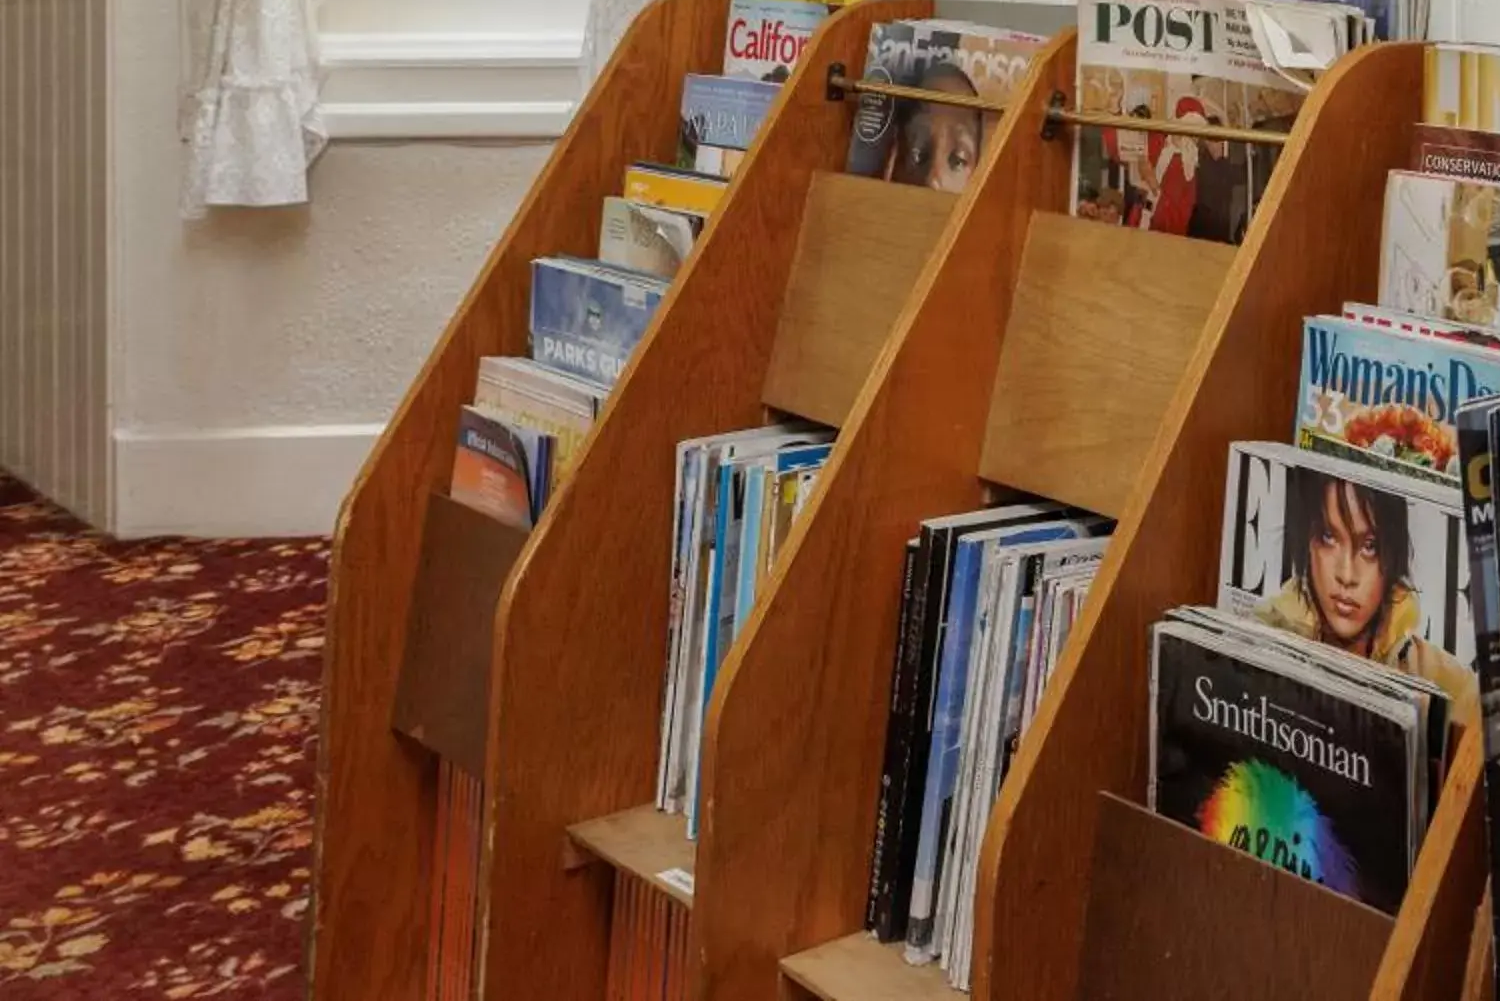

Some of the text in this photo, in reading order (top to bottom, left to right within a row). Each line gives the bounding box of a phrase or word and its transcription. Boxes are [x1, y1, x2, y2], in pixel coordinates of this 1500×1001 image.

[1091, 2, 1219, 53] POST
[543, 337, 597, 372] PARKS
[1308, 326, 1446, 422] Woman's
[1193, 676, 1372, 788] Smithsonian
